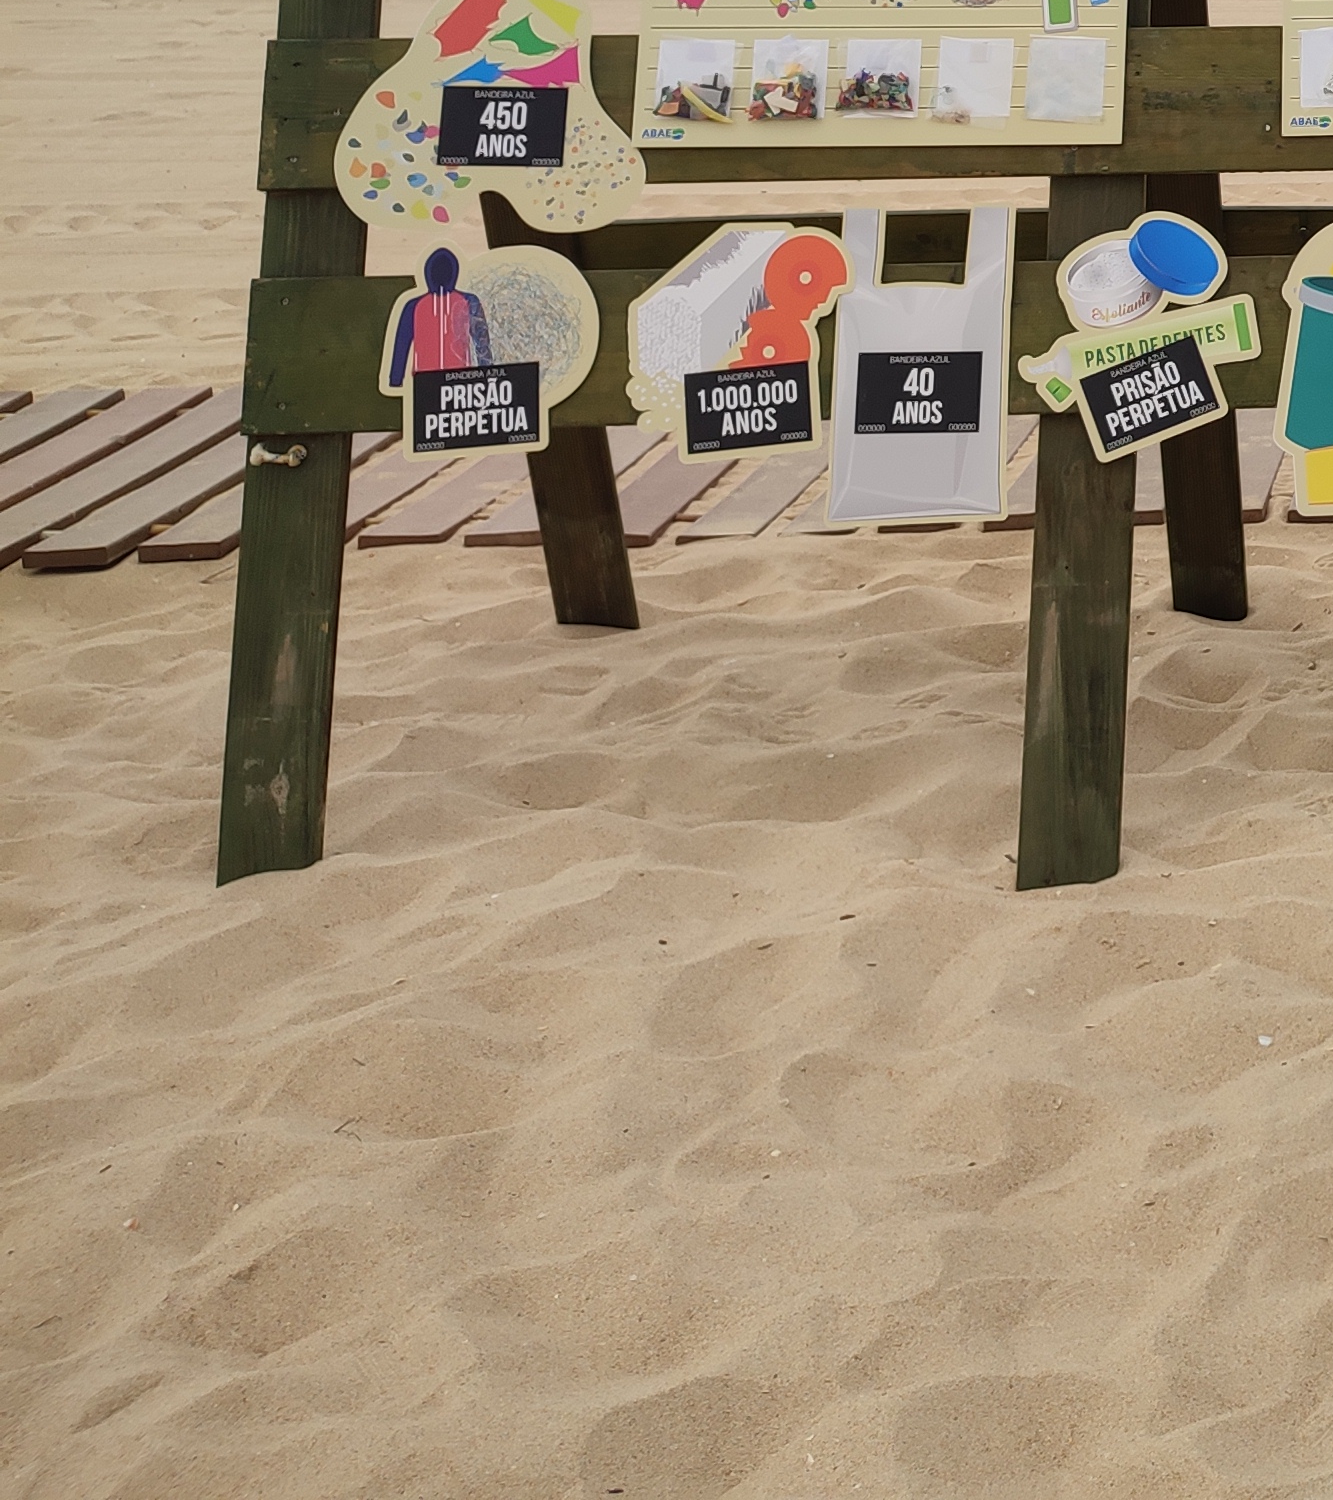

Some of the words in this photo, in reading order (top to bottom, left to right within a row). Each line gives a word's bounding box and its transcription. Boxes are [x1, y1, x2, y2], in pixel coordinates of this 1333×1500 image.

[474, 90, 513, 99] BANDEIRA
[515, 91, 536, 99] AZUL
[480, 102, 528, 130] 450
[1290, 116, 1319, 128] ABAE
[475, 134, 528, 158] ANOS
[642, 128, 672, 139] ABAE
[1092, 291, 1151, 322] Esfoliante
[890, 356, 928, 364] BANDEIRA
[930, 356, 950, 364] AZUL
[1084, 342, 1136, 368] PASTA
[1139, 337, 1158, 354] DE
[1110, 358, 1147, 378] BANDEIRA
[1147, 351, 1169, 365] AZUL
[445, 370, 485, 381] BANDEIRA
[487, 368, 505, 378] AZUL
[717, 372, 754, 383] BANDEIRA
[756, 370, 776, 380] AZUL
[903, 368, 934, 396] 40
[1110, 360, 1181, 406] PRISÃO
[440, 377, 513, 411] PRISÃO
[697, 379, 798, 413] 1.000.000
[425, 403, 528, 439] PERPÉTUA
[721, 408, 778, 437] ANOS
[892, 401, 943, 425] ANOS
[1105, 380, 1204, 437] PERPÉTUA
